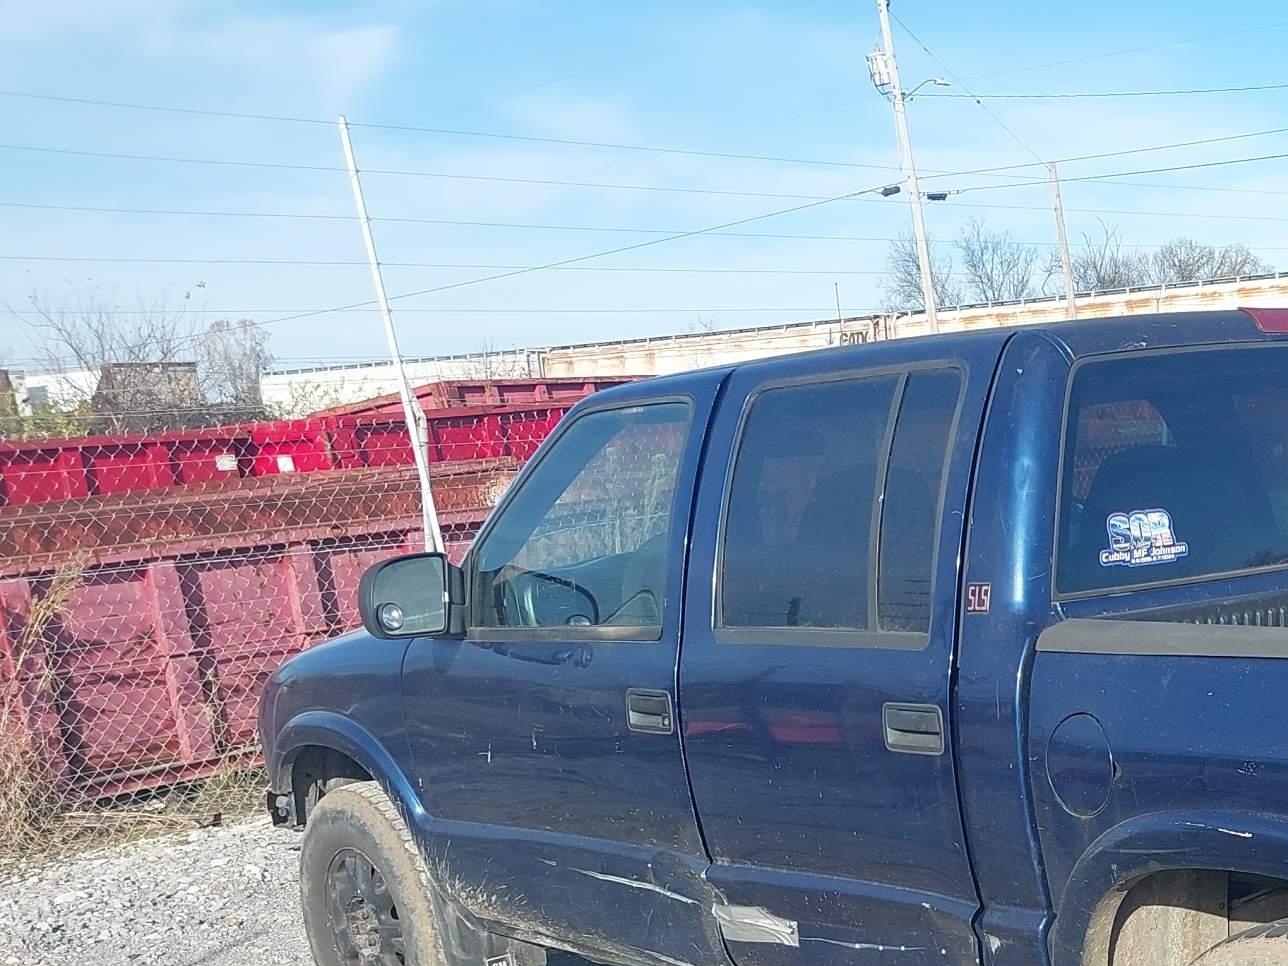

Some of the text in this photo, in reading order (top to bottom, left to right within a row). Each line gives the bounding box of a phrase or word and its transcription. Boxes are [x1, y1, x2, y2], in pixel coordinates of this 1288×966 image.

[1102, 551, 1131, 563] Cubby
[1150, 545, 1186, 557] Johnson
[967, 585, 989, 611] SLS
